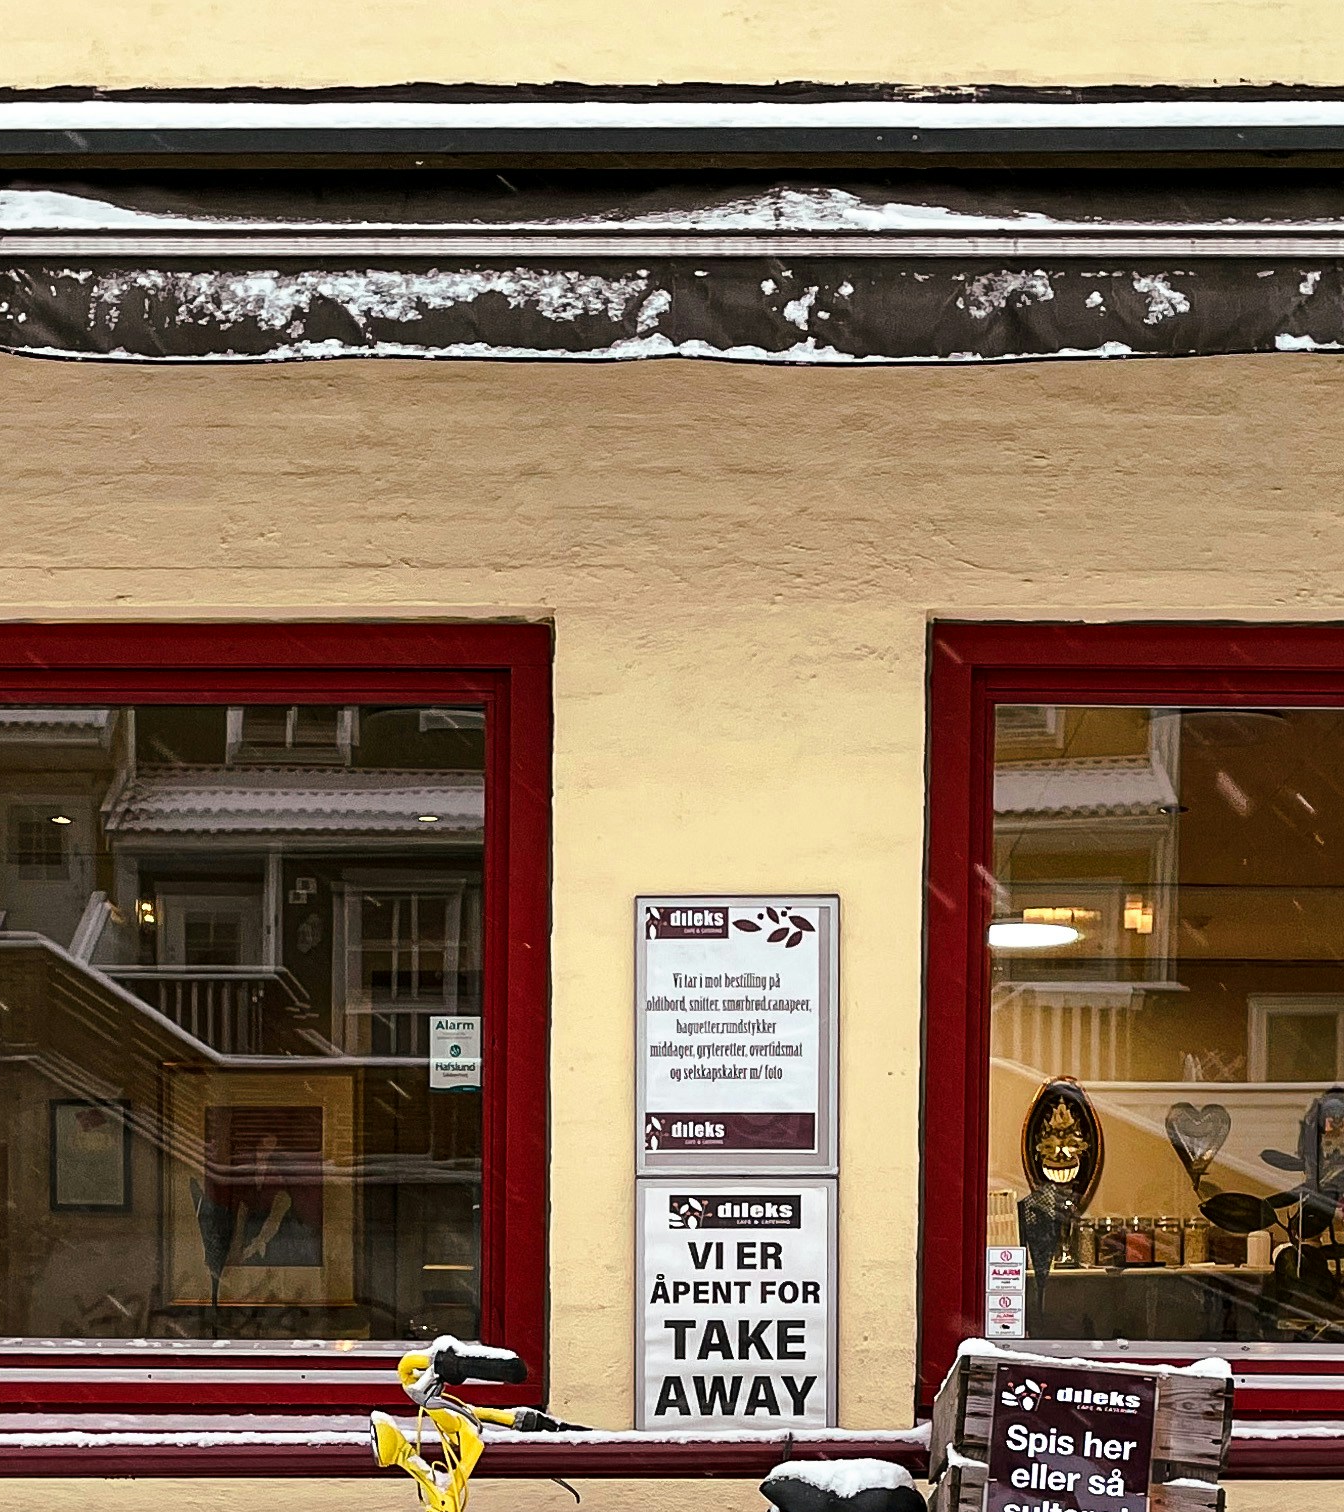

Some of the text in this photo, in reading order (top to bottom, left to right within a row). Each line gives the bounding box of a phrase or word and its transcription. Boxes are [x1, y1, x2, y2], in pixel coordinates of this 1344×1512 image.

[670, 910, 724, 927] dileks
[672, 972, 682, 988] Vi
[684, 974, 697, 988] tar
[705, 974, 722, 988] mot
[724, 973, 767, 990] bestilling
[769, 973, 781, 990] på
[644, 996, 688, 1012] oldtbord,
[436, 1020, 474, 1030] Alarm
[749, 1041, 803, 1057] overtidsmat
[670, 1067, 681, 1082] og
[683, 1064, 748, 1082] selskapskaker
[765, 1064, 783, 1079] foto
[671, 1121, 725, 1138] dileks
[717, 1202, 793, 1218] dileks
[687, 1241, 783, 1270] VI ER
[991, 1268, 1021, 1276] ALARM
[650, 1273, 820, 1304] ÅPENT FOR
[664, 1319, 806, 1361] TAKE
[654, 1375, 817, 1417] AWAY
[1056, 1387, 1141, 1408] dileks
[1006, 1423, 1137, 1461] Spis her
[1010, 1463, 1125, 1497] eller så
